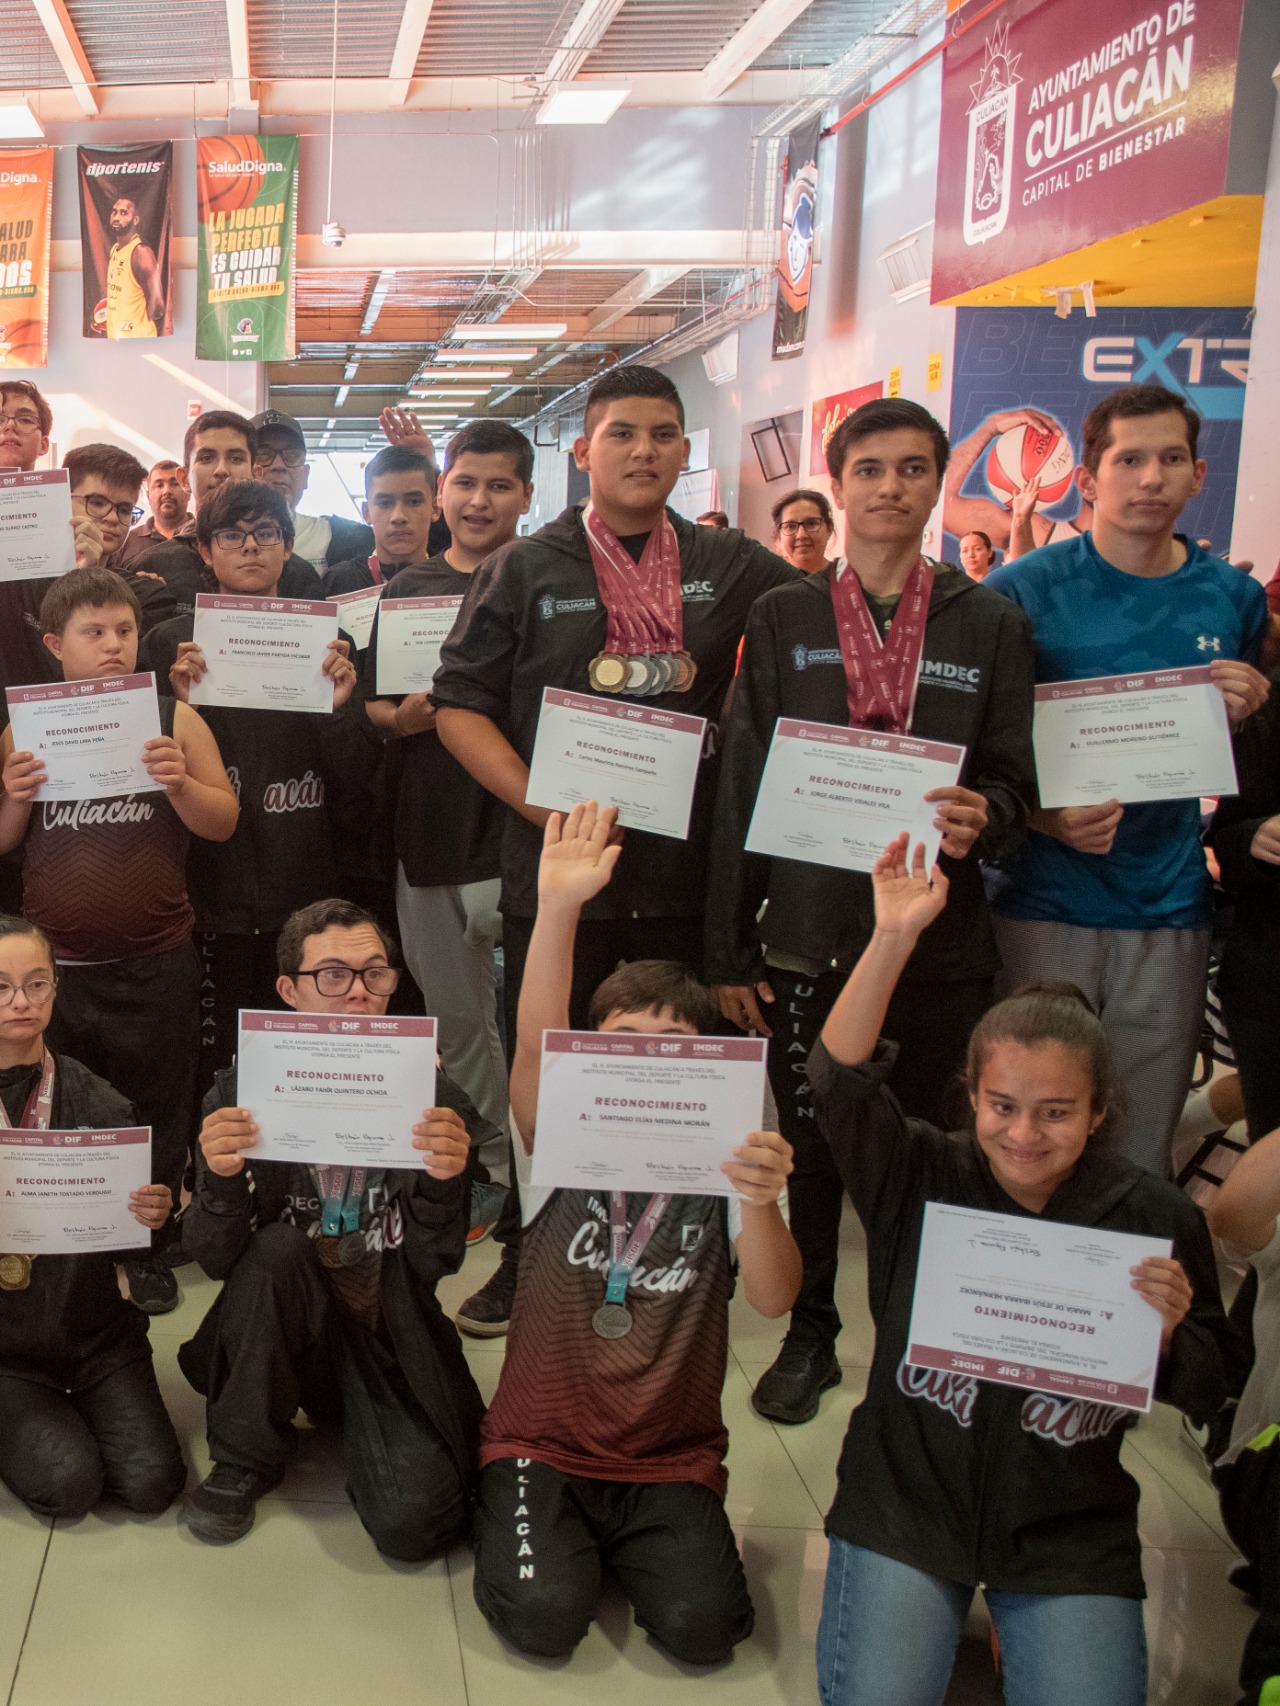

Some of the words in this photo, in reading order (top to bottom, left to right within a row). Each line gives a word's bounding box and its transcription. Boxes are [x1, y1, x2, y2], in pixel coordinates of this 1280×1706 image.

[1028, 14, 1162, 115] AYUNTAMIENTO
[1166, 0, 1195, 36] DE
[1025, 34, 1194, 168] CULIACÁN
[208, 160, 283, 175] SaludDigna
[1022, 171, 1070, 206] CAPITAL
[1076, 159, 1093, 182] DE
[1098, 116, 1186, 172] BIENESTAR
[86, 162, 161, 177] dportenis
[209, 211, 226, 232] LA
[229, 203, 285, 230] JUGADA
[212, 226, 280, 253] PERFECTA
[211, 253, 227, 273] ES
[230, 246, 281, 272] CUIDAR
[214, 272, 230, 290] TU
[233, 267, 278, 287] SALUD
[292, 603, 311, 611] IMDEC
[229, 638, 300, 648] RECONOCIMIENTO
[103, 680, 124, 688] IMDEC
[1127, 679, 1145, 689] DIF
[1155, 674, 1182, 683] IMDEC
[46, 722, 120, 736] RECONOCIMIENTO
[1080, 720, 1176, 735] RECONOCIMIENTO
[576, 741, 656, 763] RECONOCIMIENTO
[872, 738, 889, 747] DIF
[899, 741, 927, 753] IMDEC
[809, 775, 901, 796] RECONOCIMIENTO
[43, 793, 154, 830] Culiacán
[342, 1022, 360, 1030] DIF
[371, 1022, 399, 1030] IMDEC
[661, 1043, 682, 1052] DIF
[693, 1043, 724, 1052] IMDEC
[287, 1070, 385, 1082] RECONOCIMIENTO
[274, 1085, 284, 1093] A:
[334, 1087, 364, 1095] QUINTERO
[595, 1096, 707, 1112] RECONOCIMIENTO
[579, 1113, 591, 1121] A:
[600, 1114, 634, 1122] SANTIAGO
[655, 1117, 682, 1126] MEDINA
[684, 1118, 710, 1127] MORÁN
[65, 1136, 81, 1144] DIF
[16, 1177, 106, 1185] RECONOCIMIENTO
[1066, 1307, 1091, 1316] MARÍA
[1100, 1310, 1113, 1320] A:
[974, 1305, 1095, 1335] RECONOCIMIENTO
[951, 1358, 984, 1372] IMDEC
[997, 1366, 1020, 1378] DIF
